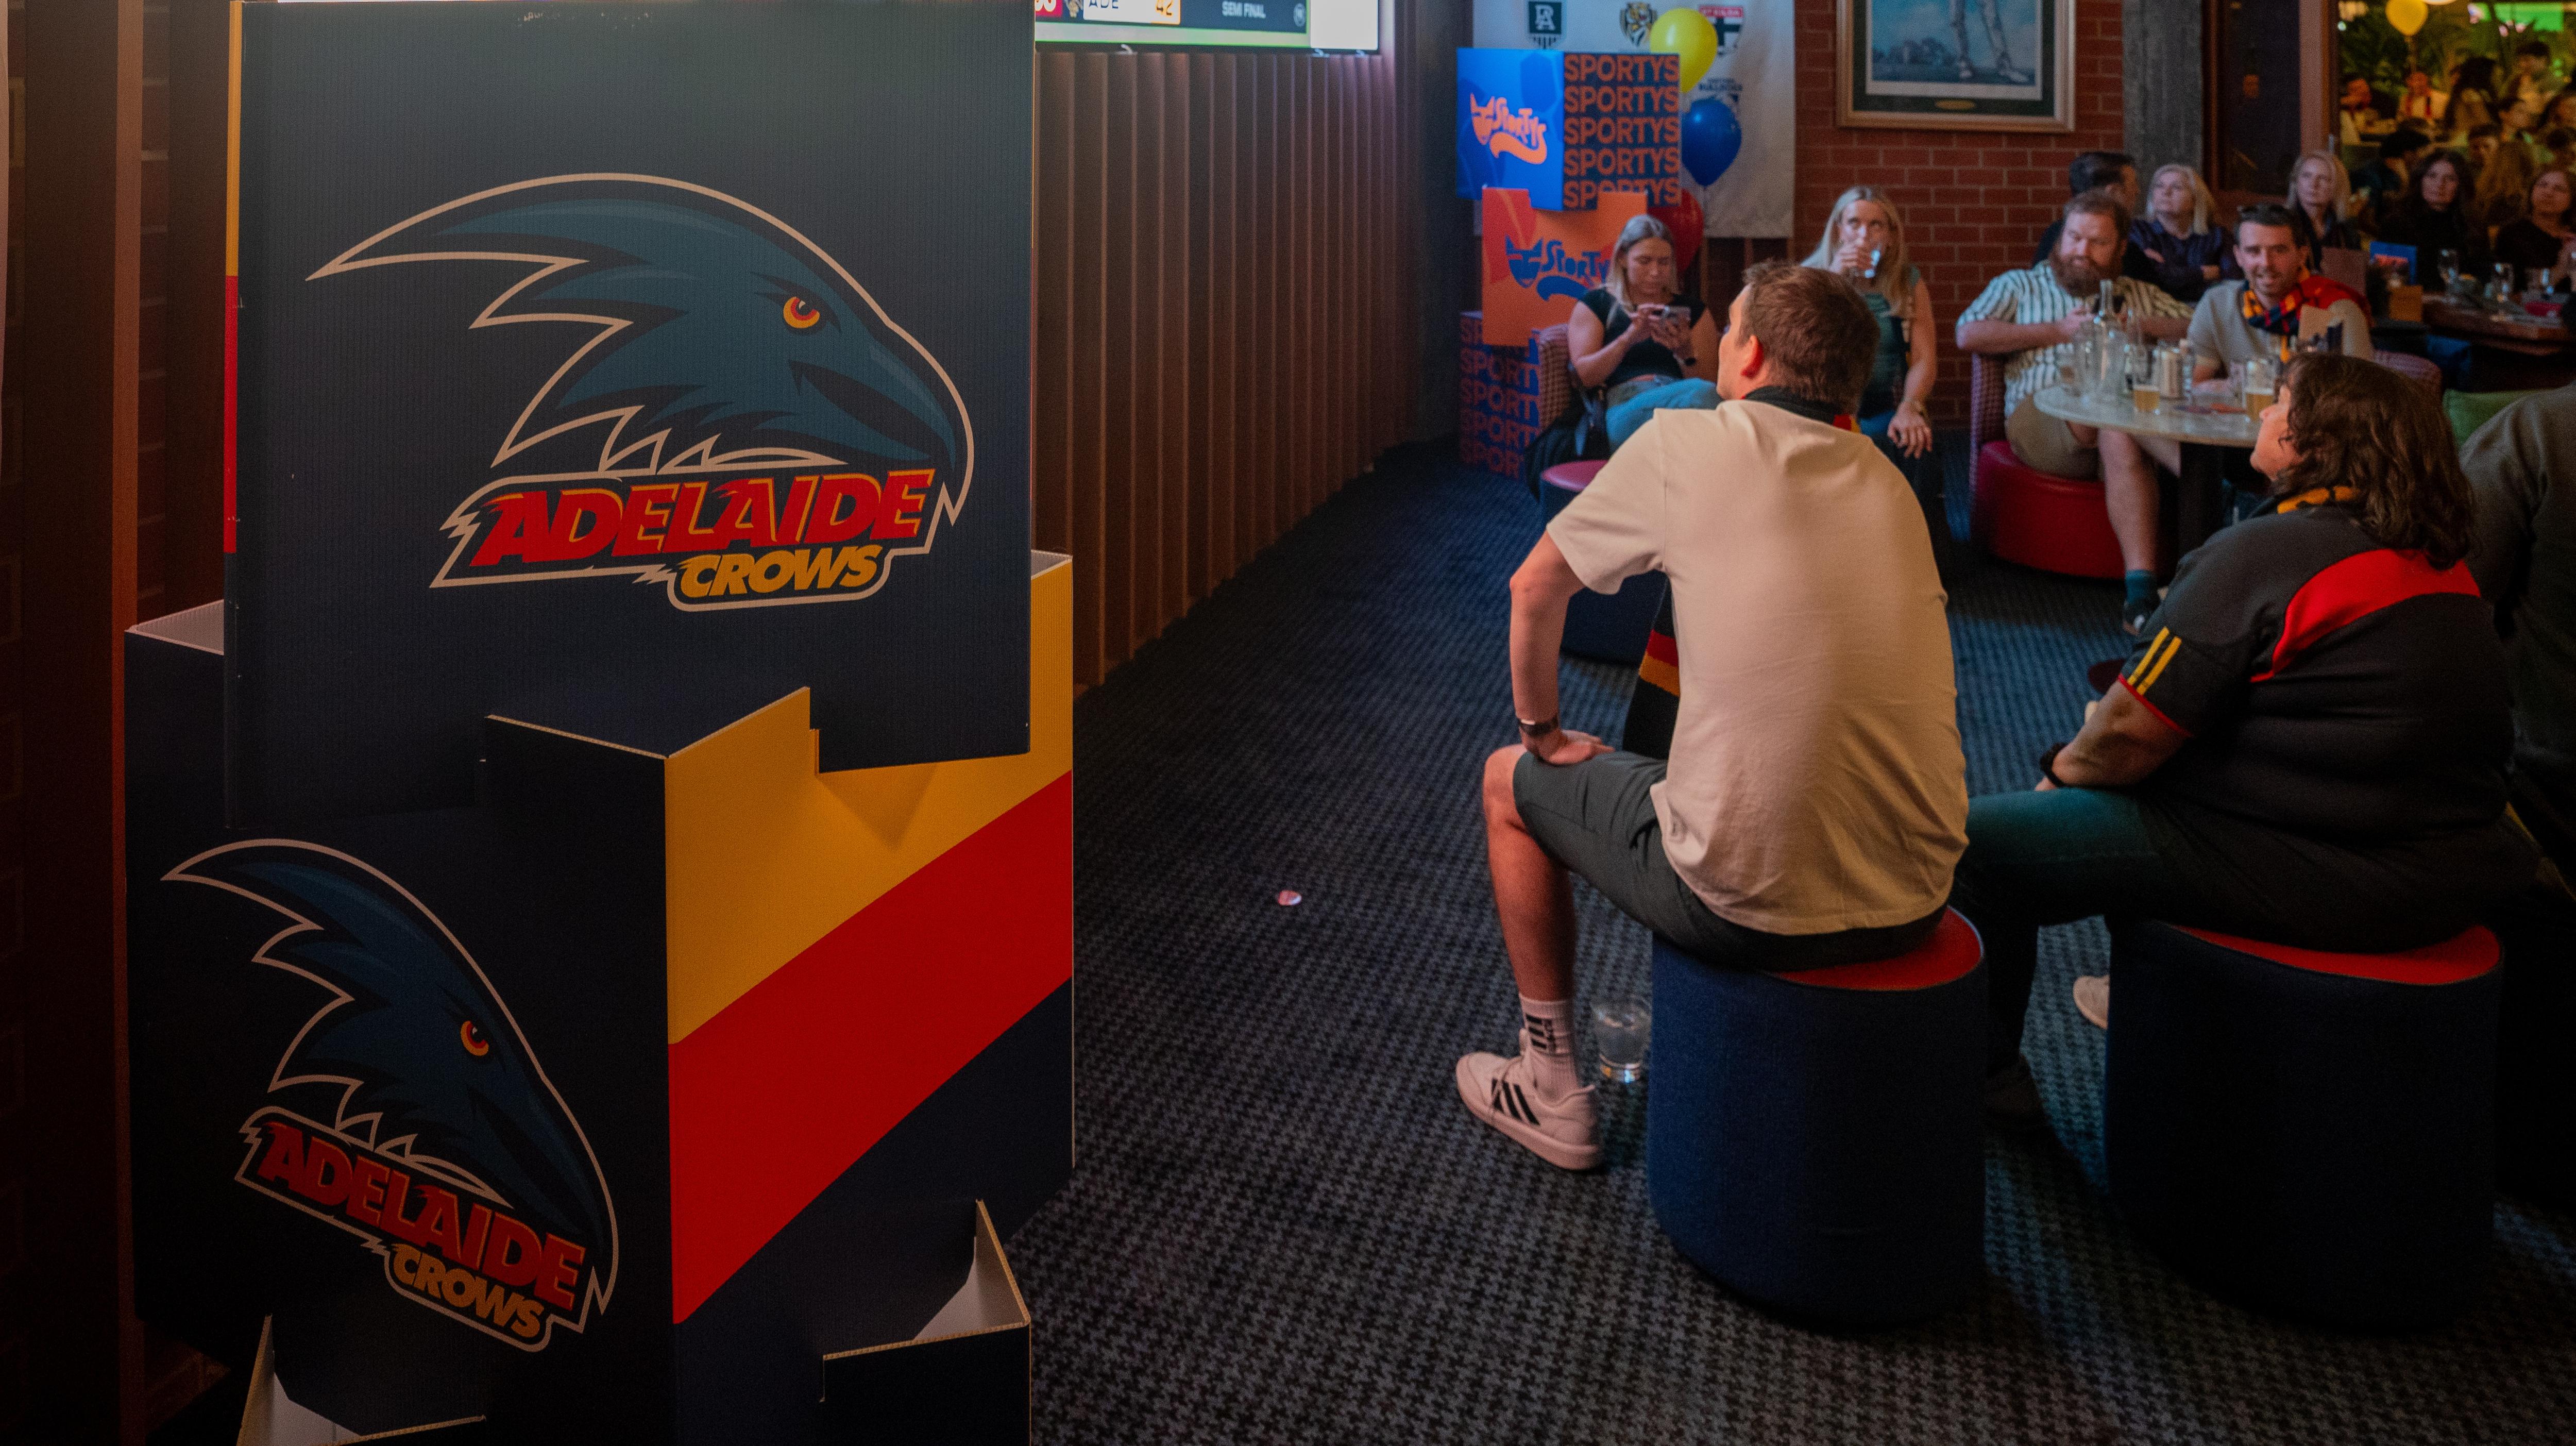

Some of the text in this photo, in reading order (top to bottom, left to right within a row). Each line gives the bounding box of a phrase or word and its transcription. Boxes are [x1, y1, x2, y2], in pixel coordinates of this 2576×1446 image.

[1222, 1, 1266, 19] SEMI FINAL
[1563, 54, 1680, 82] SPORTYS
[1563, 86, 1680, 113] SPORTYS
[1563, 117, 1680, 145] SPORTYS
[1563, 147, 1680, 176] SPORTYS
[1538, 240, 1610, 300] SPORTY
[1461, 348, 1540, 388] SPORT
[1461, 377, 1540, 421] SPORT
[1461, 408, 1540, 449] SPORT
[1461, 437, 1524, 479] SPOR
[470, 468, 935, 567] ADELAIDE
[678, 544, 883, 597] CROWS
[257, 1120, 586, 1312] ADELAIDE
[390, 1243, 545, 1338] CROWS
